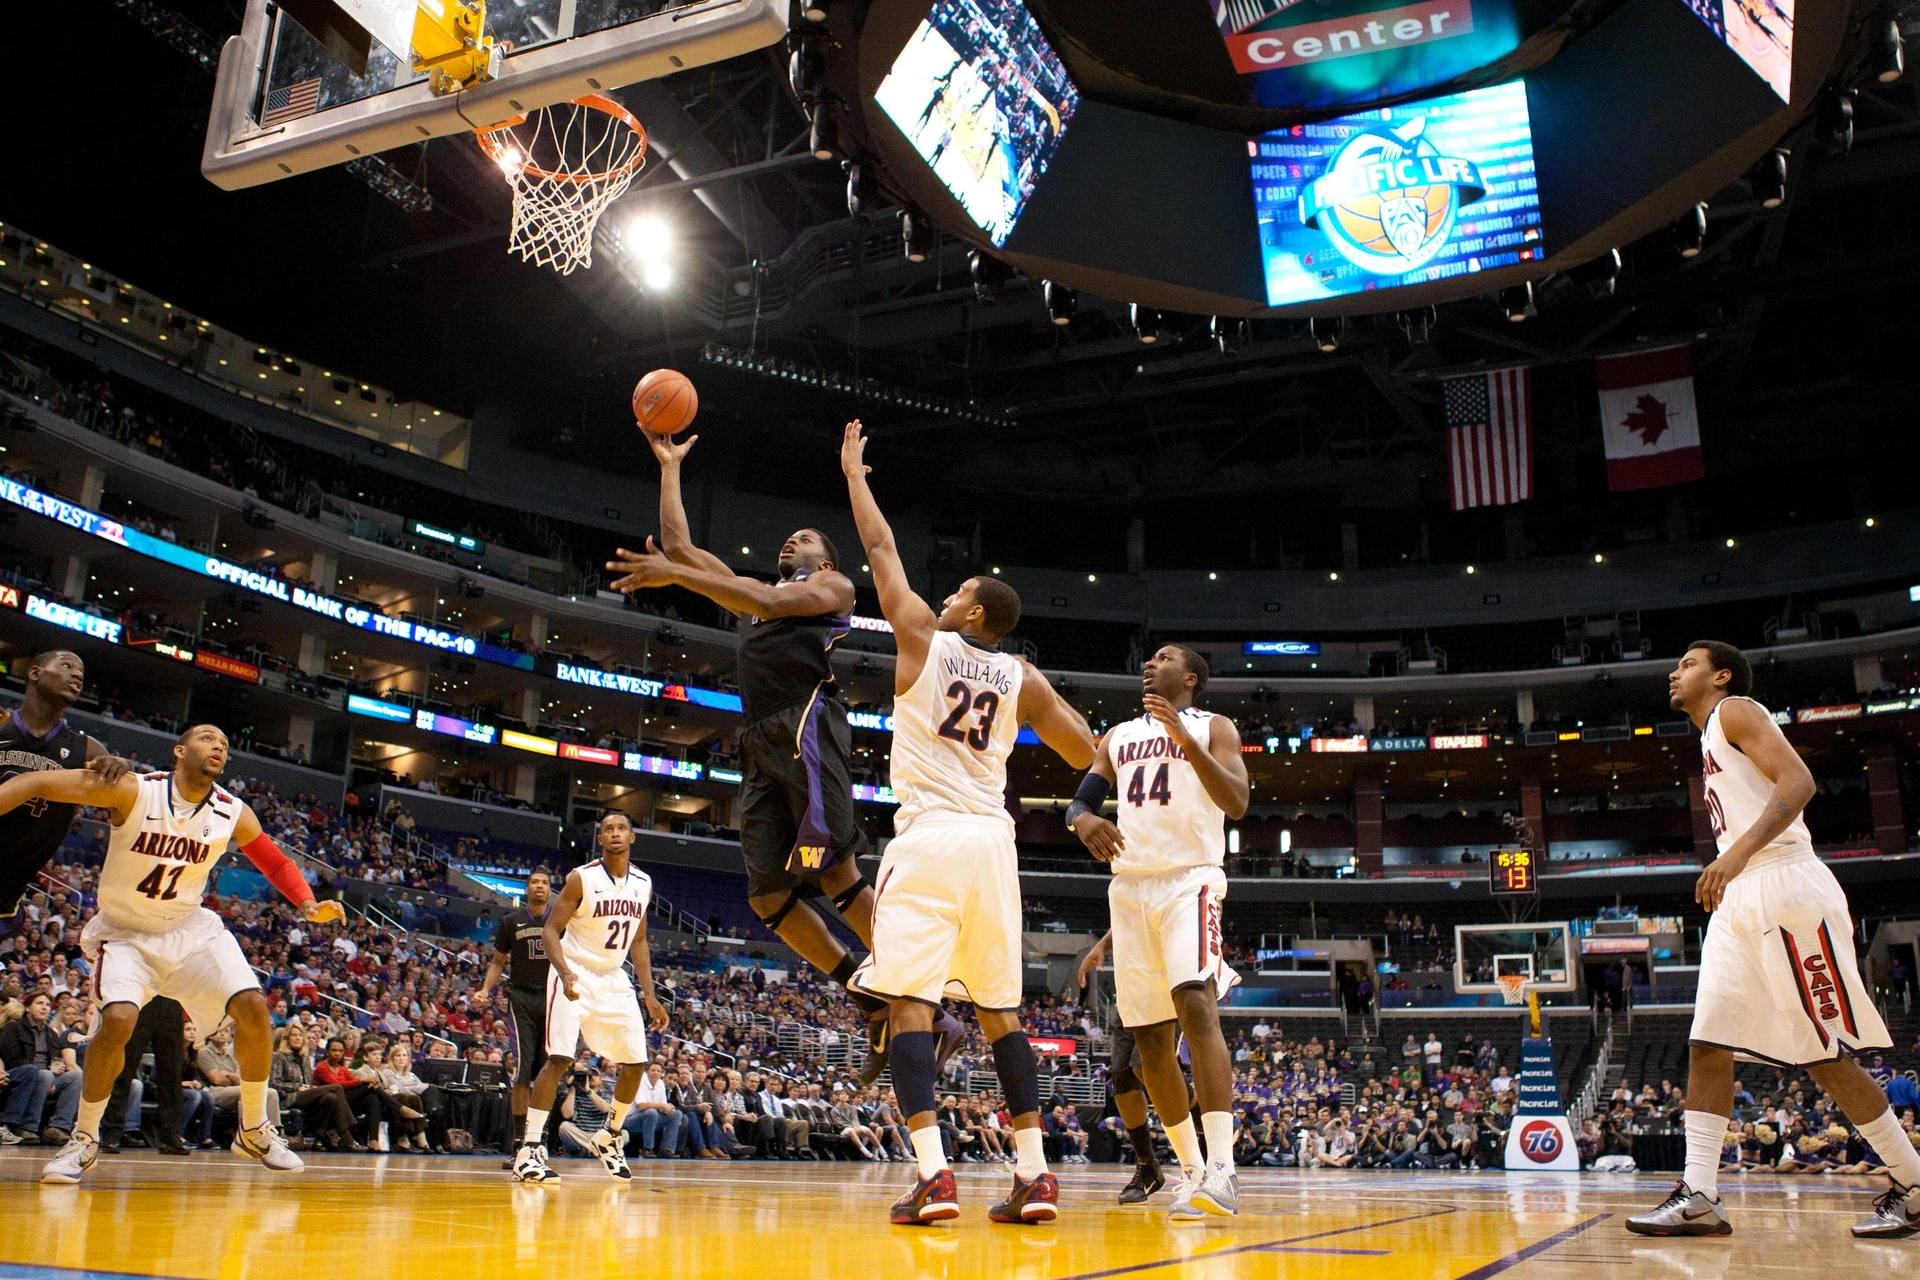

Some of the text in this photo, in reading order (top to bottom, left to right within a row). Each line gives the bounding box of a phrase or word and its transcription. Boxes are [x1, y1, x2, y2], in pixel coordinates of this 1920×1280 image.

[1247, 11, 1451, 65] Center
[1260, 143, 1308, 158] MADNESS
[1265, 186, 1298, 201] COAST
[1314, 157, 1475, 208] PIFIC LIFE
[1475, 216, 1514, 235] MADNESS
[1460, 238, 1484, 255] COAST
[42, 494, 98, 533] WEST
[205, 558, 475, 656] OFFICIAL BANK OF THE PAC-10
[25, 594, 122, 644] PACIFIC LIFE
[849, 615, 895, 633] OYOTA
[1280, 642, 1310, 651] LIGHT
[196, 653, 259, 679] WELLS FARGO
[557, 662, 665, 698] BANK OF THE WEST
[846, 712, 882, 730] ANK
[937, 680, 999, 752] 23
[1800, 706, 1862, 722] Budweiser
[1384, 739, 1427, 750] DELTA
[1433, 736, 1483, 749] STAPLES
[0, 750, 65, 771] SHINGTO
[1127, 762, 1172, 808] 44
[130, 831, 210, 865] ARIZONA
[798, 846, 826, 869] W
[1498, 851, 1530, 867] 15:36
[136, 864, 185, 901] 42
[1508, 866, 1527, 889] 13
[593, 899, 642, 920] ARIZONA
[605, 919, 631, 950] 21
[1803, 953, 1840, 1021] CATS
[1520, 1084, 1543, 1092] PACIFIC
[1519, 1099, 1559, 1108] PACIFIC LIFE
[1525, 1128, 1558, 1154] 76
